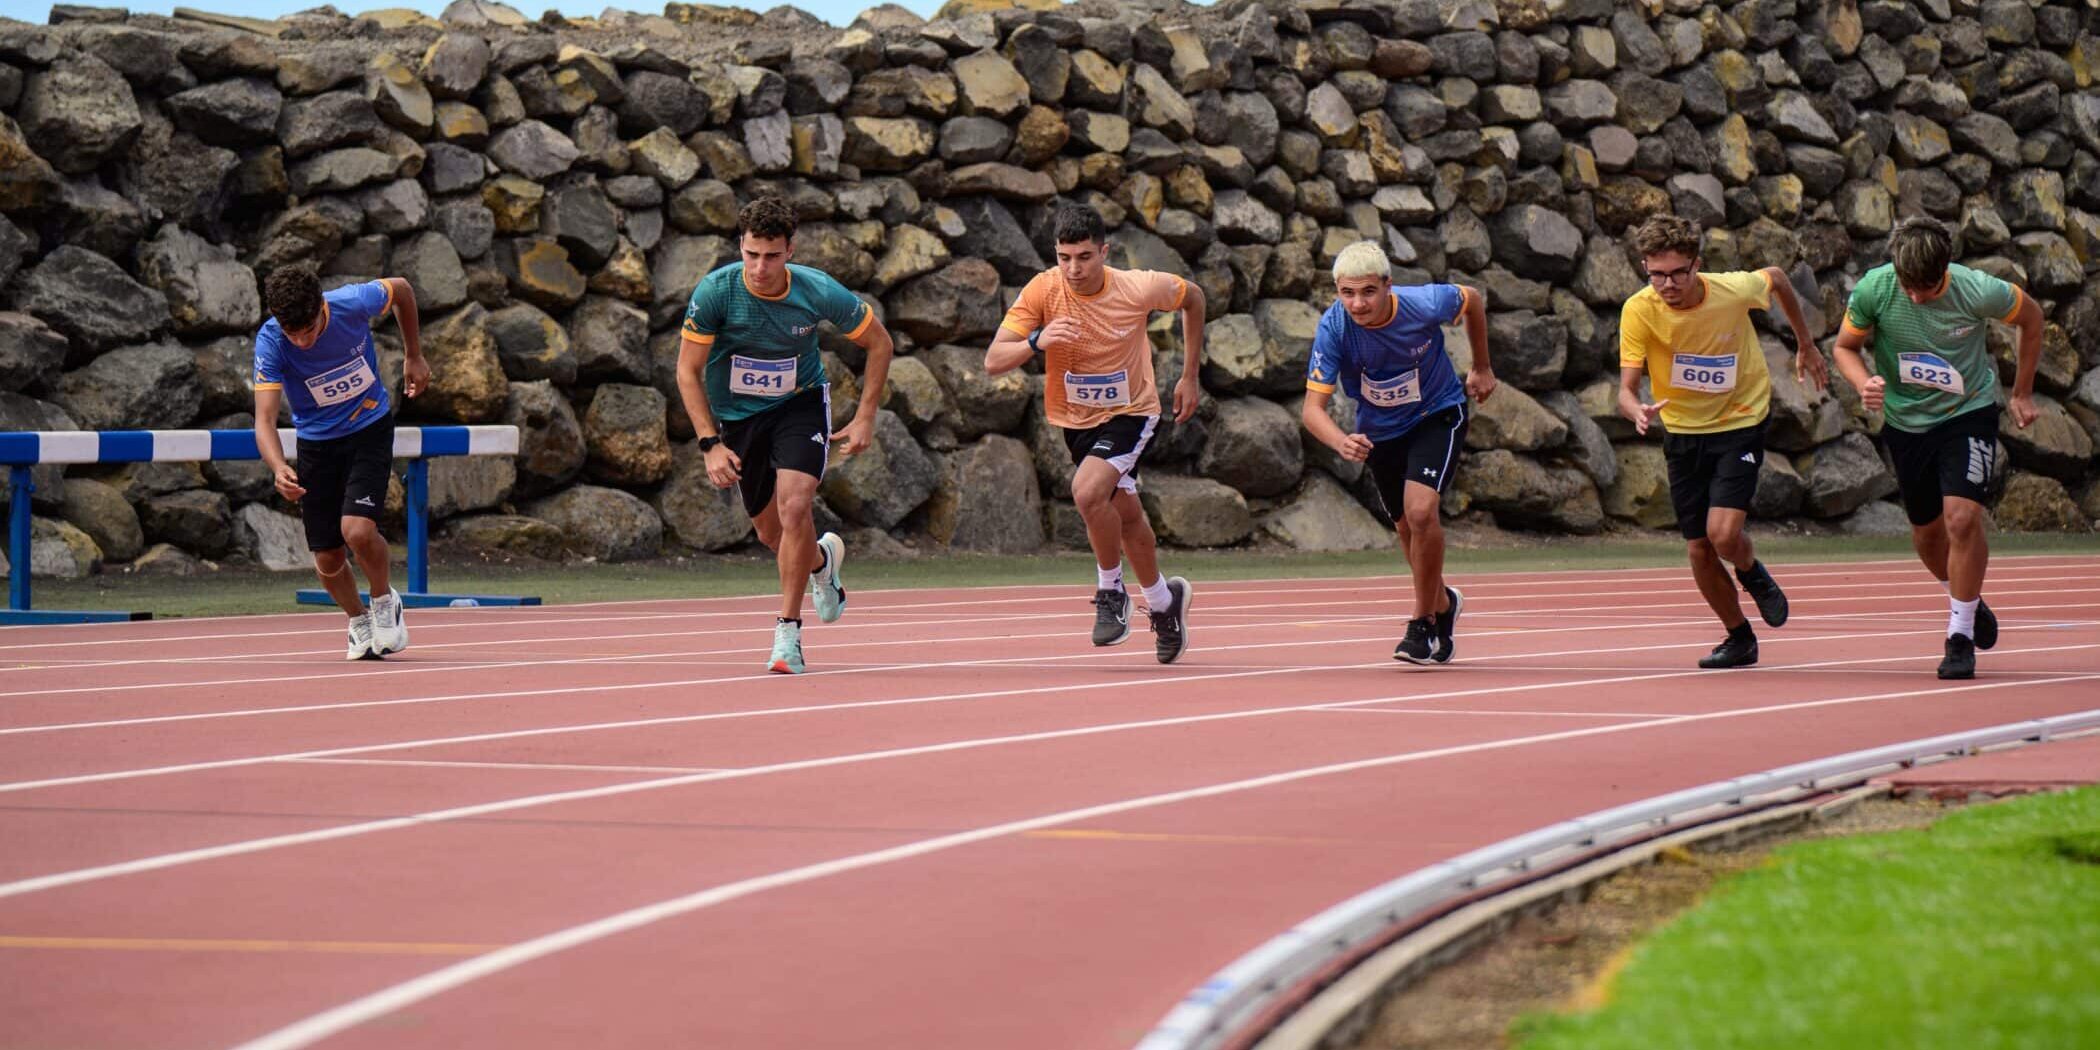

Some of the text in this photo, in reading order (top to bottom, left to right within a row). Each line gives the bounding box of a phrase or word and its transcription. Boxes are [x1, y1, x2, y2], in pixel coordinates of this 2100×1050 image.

[742, 372, 783, 388] 641
[1683, 368, 1725, 385] 606
[1910, 366, 1952, 385] 623
[323, 373, 364, 398] 595
[1076, 387, 1118, 400] 578
[1369, 384, 1409, 401] 535
